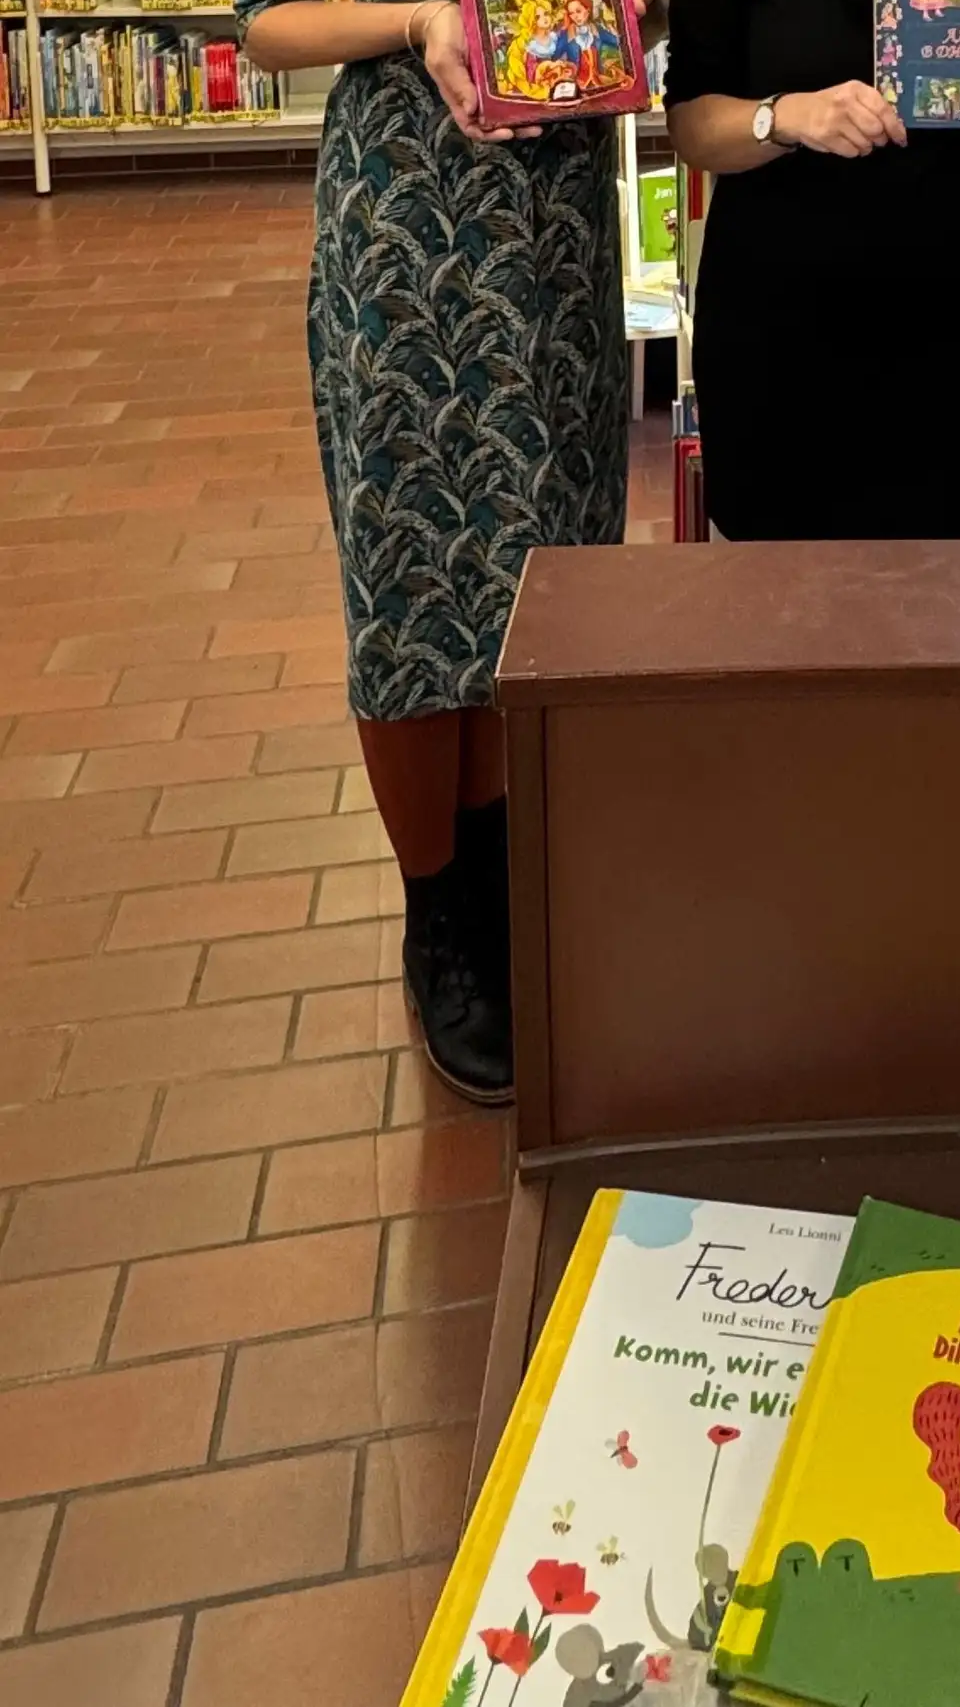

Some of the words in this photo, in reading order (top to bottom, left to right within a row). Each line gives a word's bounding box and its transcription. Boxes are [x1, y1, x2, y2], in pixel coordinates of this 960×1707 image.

[798, 1227, 843, 1242] Lionni
[702, 1311, 736, 1326] und
[740, 1316, 785, 1332] seine
[614, 1335, 716, 1376] Komm,
[727, 1352, 779, 1379] wir
[689, 1380, 739, 1411] die
